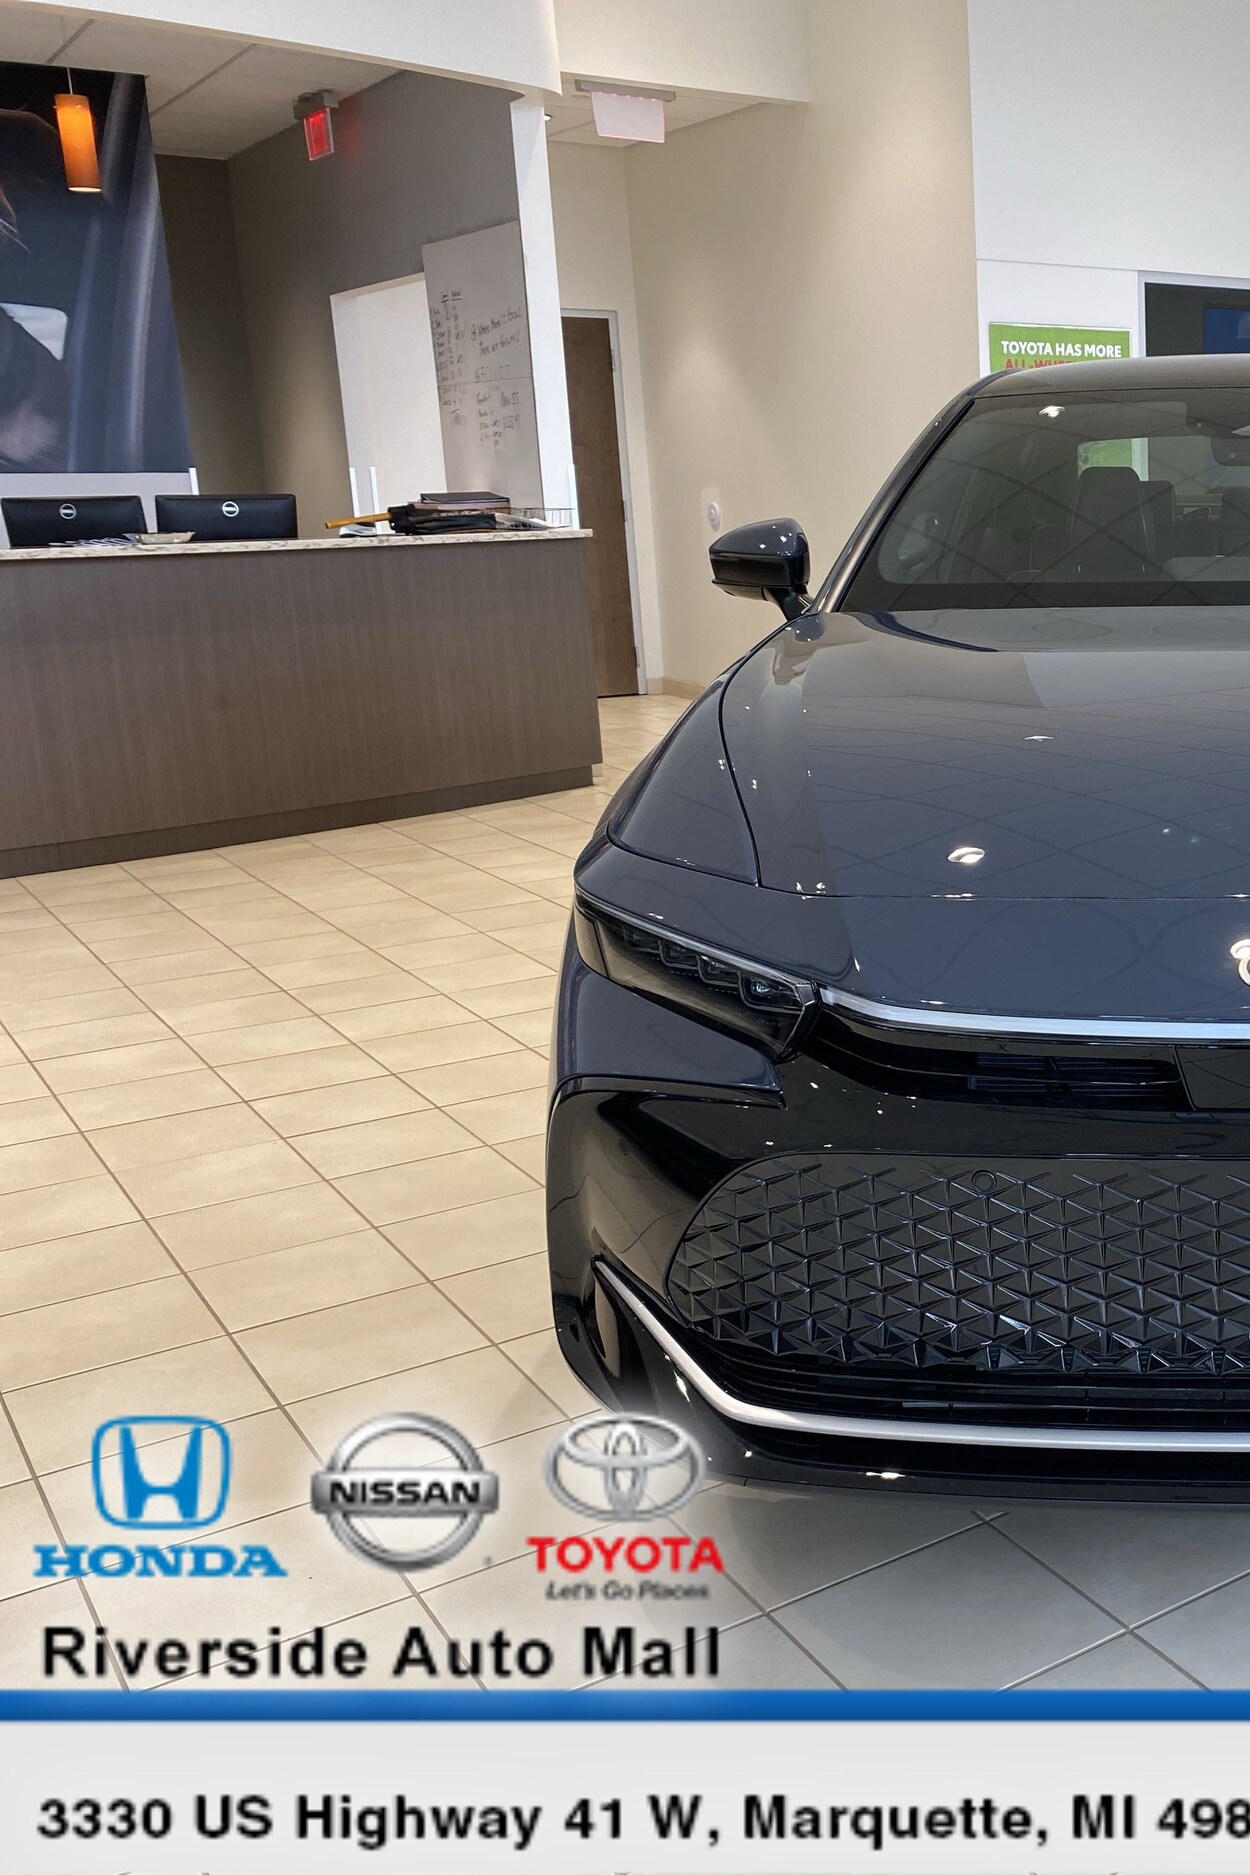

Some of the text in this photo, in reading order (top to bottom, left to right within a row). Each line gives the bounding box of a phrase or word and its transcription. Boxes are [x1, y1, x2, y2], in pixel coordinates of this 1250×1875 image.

[1001, 340, 1122, 358] TOYOTA HAS MORE
